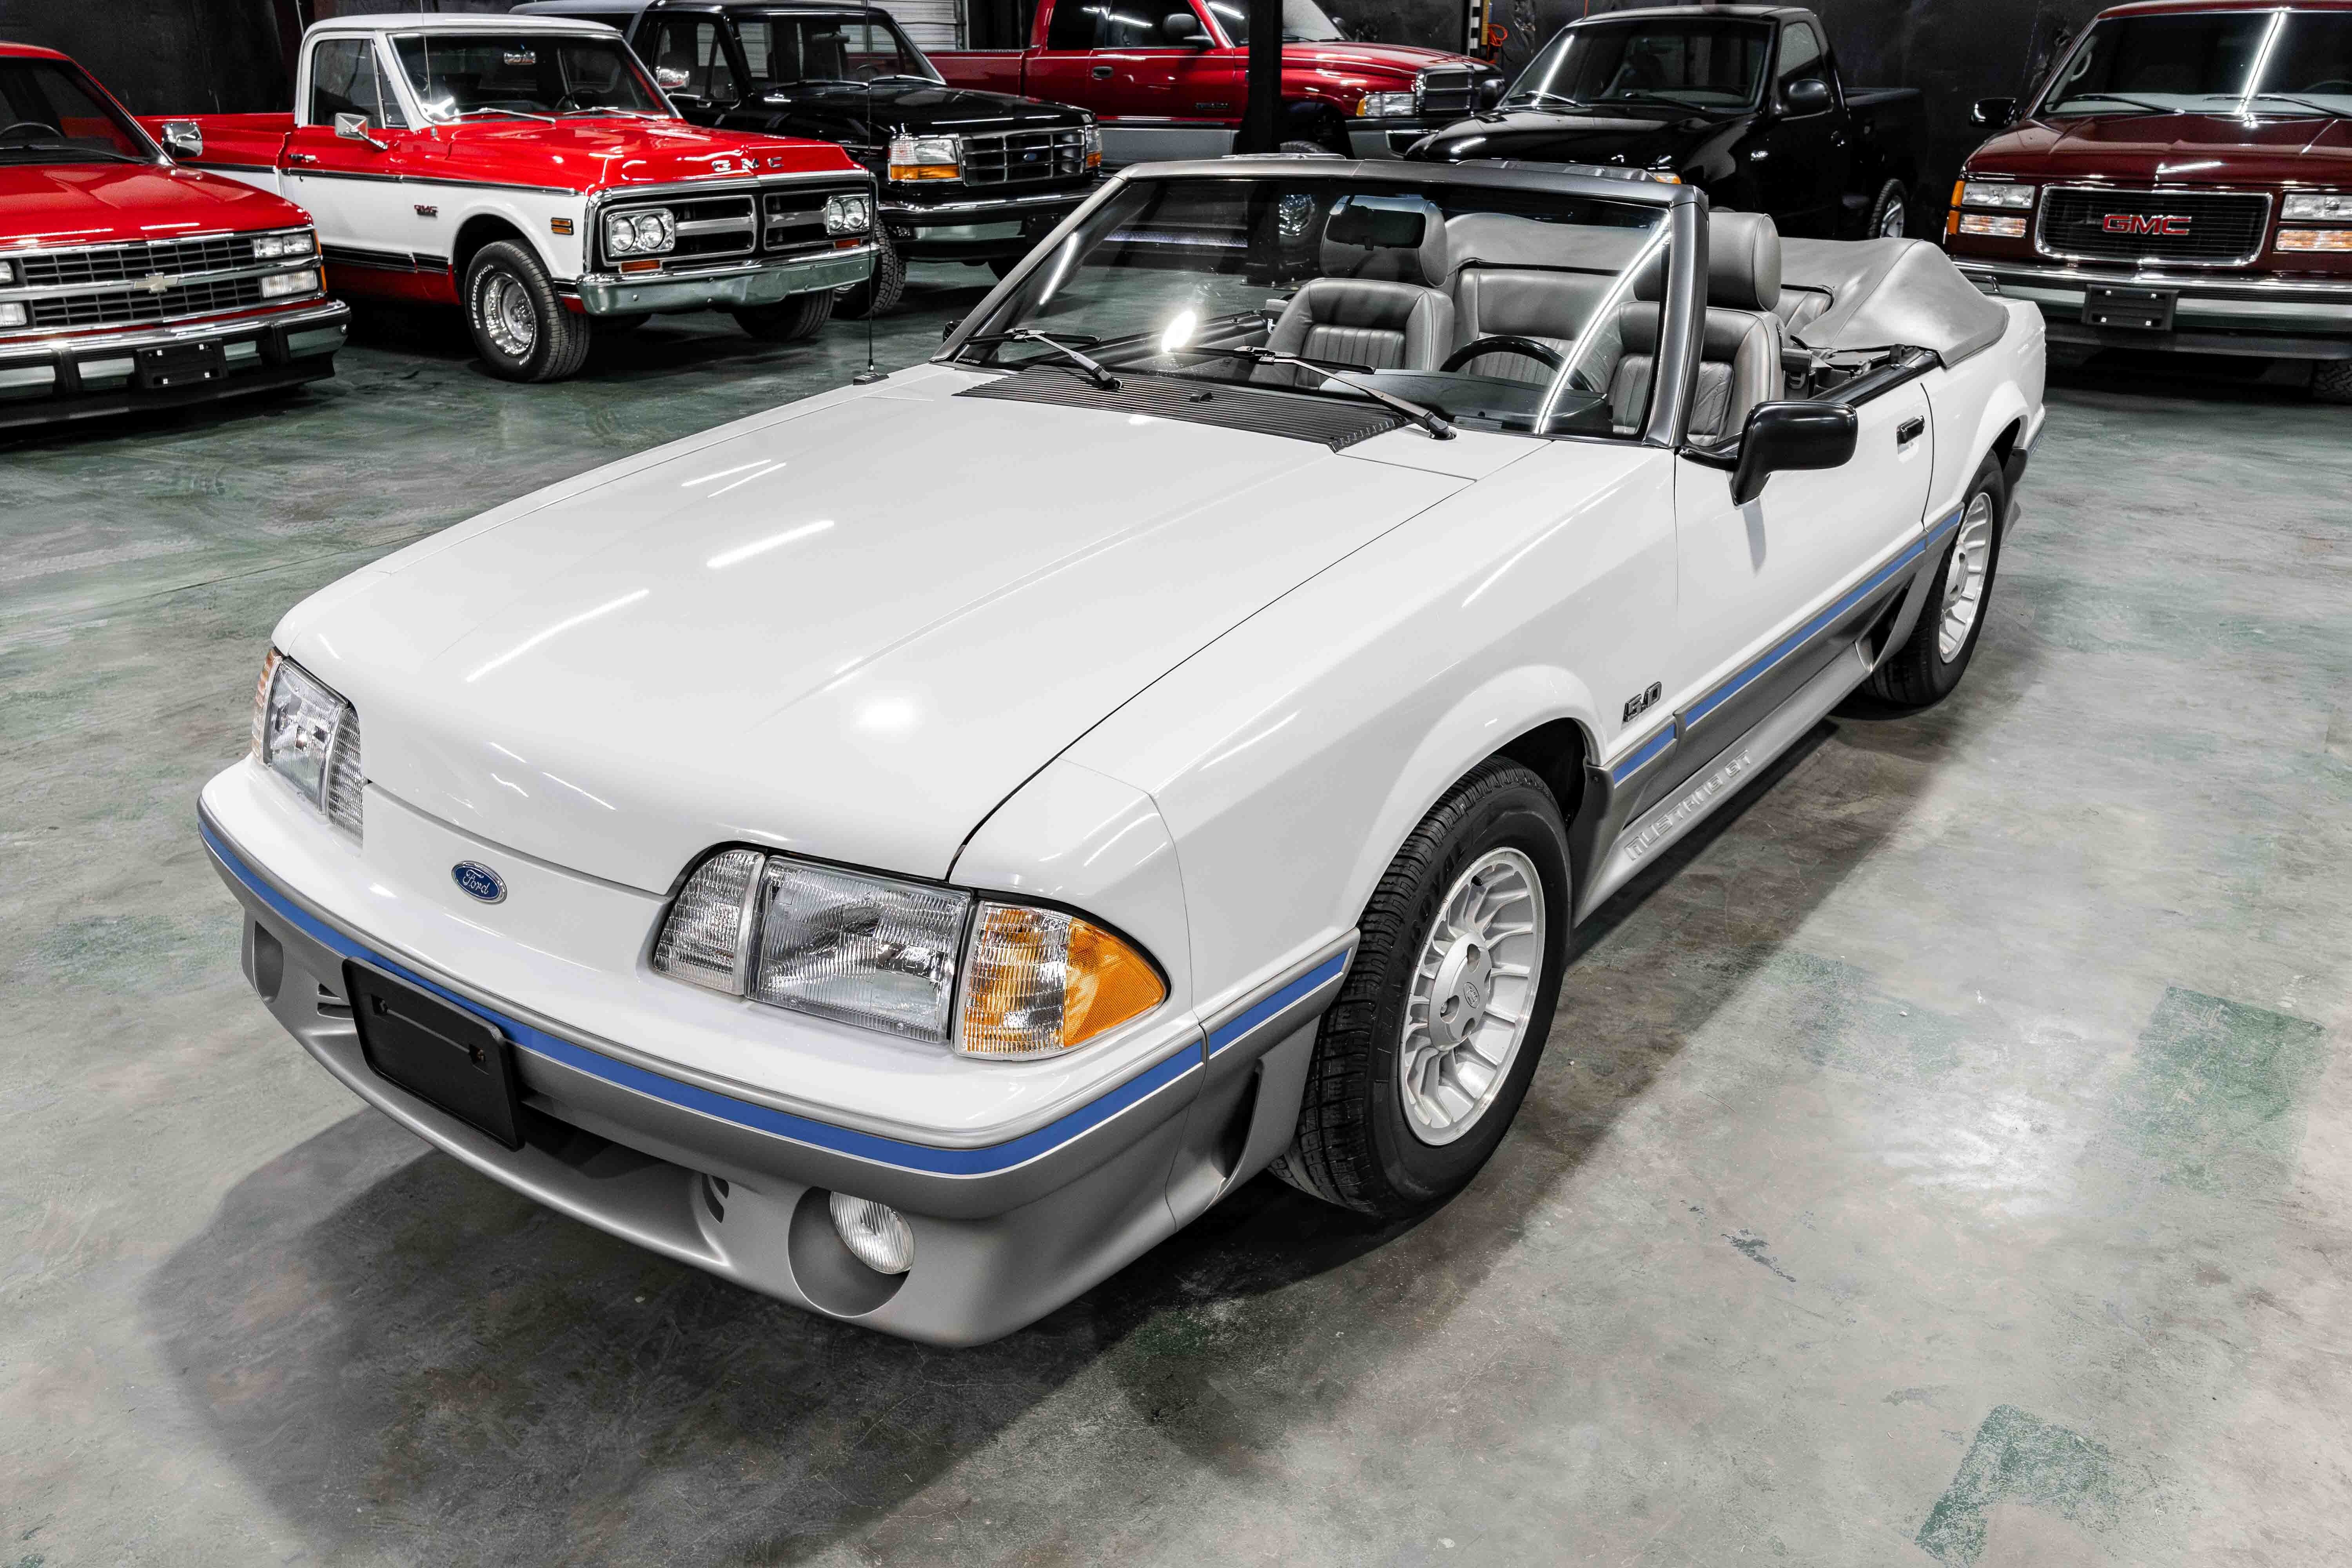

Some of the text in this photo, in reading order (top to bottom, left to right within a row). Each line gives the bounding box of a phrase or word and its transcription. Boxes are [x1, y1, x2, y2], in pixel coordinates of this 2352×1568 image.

[711, 157, 784, 172] GMC
[2103, 213, 2192, 235] GMC
[1623, 681, 1662, 722] 5.0
[1624, 749, 1750, 861] MUSTANG GT
[462, 869, 491, 895] Ford
